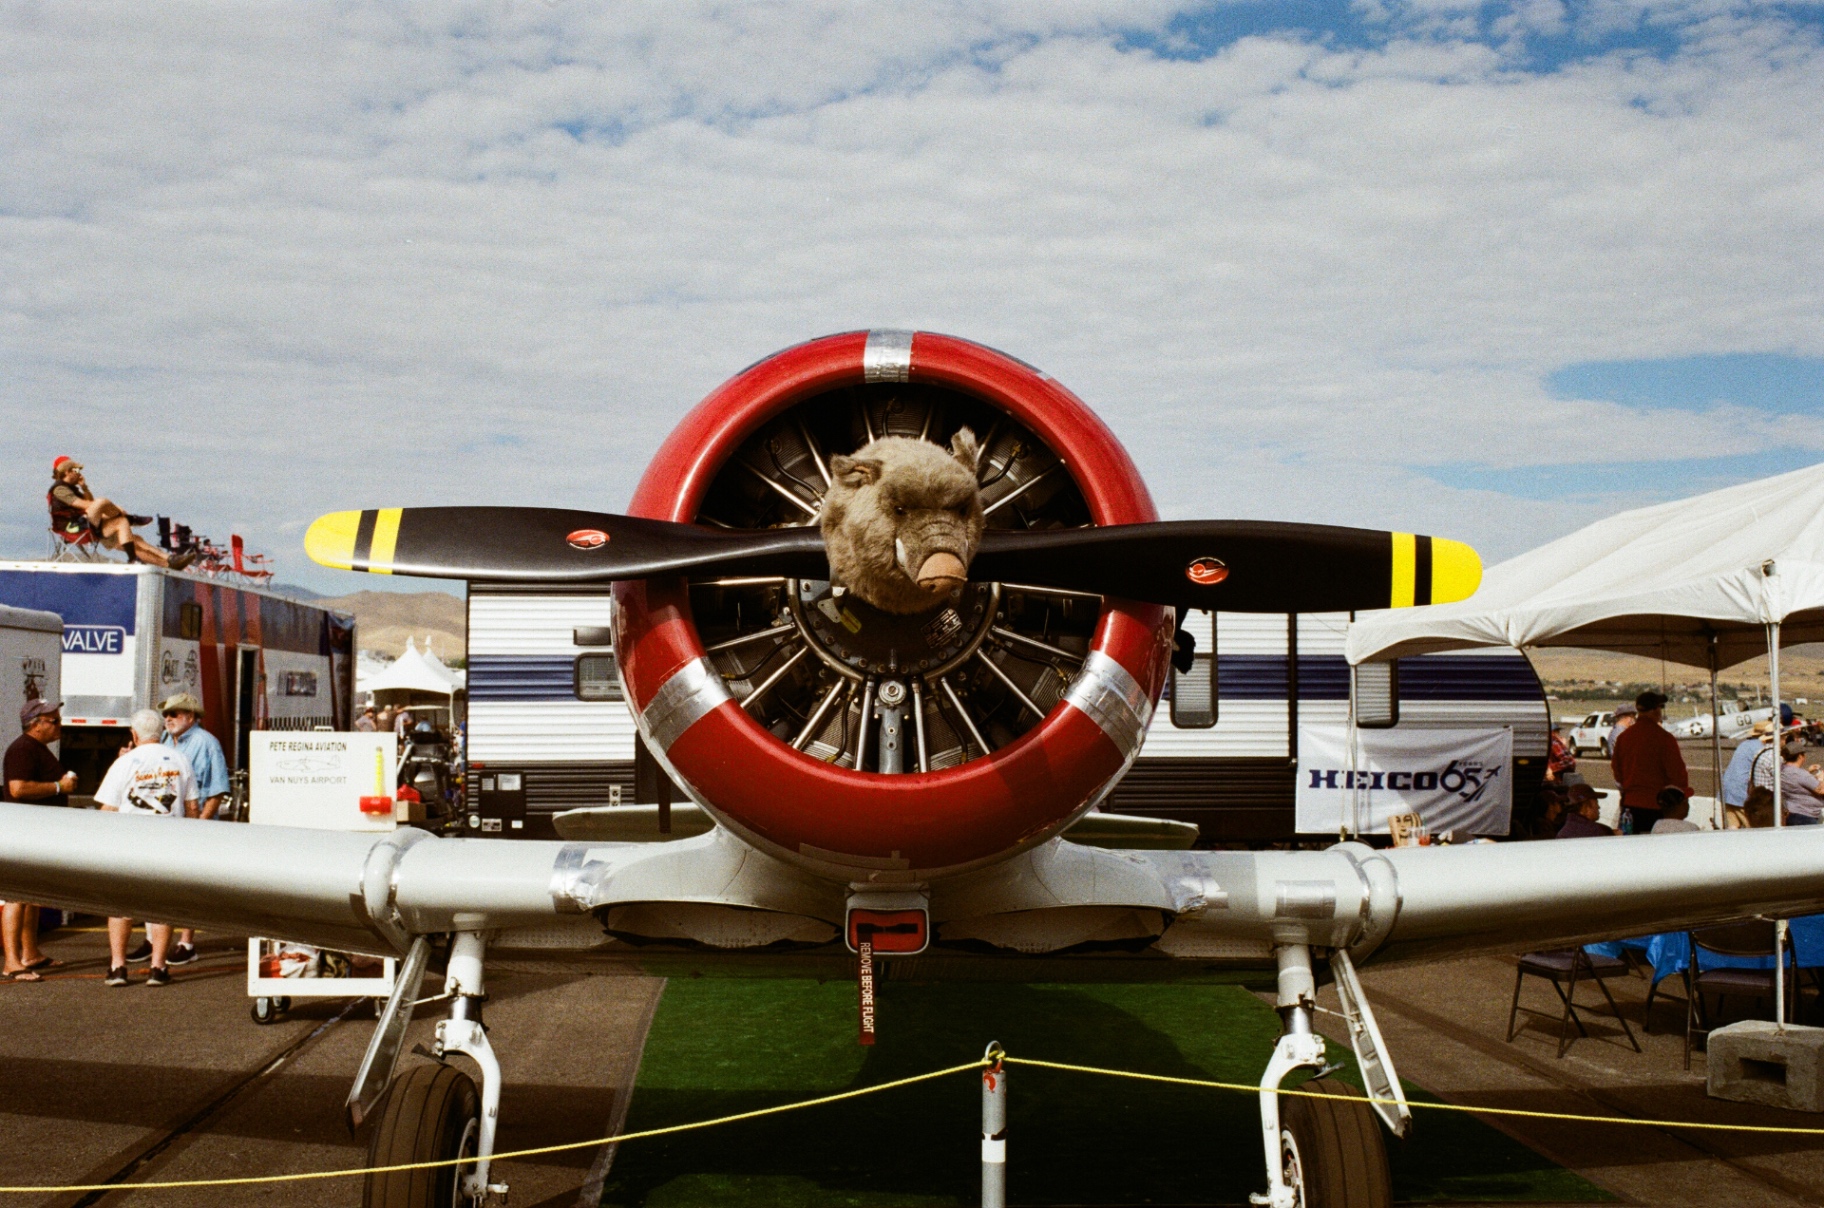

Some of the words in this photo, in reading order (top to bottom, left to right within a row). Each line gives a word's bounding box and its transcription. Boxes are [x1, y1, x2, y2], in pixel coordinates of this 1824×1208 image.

[62, 630, 118, 651] VALVE
[1736, 714, 1752, 727] GQ
[269, 741, 287, 751] PETE
[288, 741, 313, 751] REGINA
[315, 741, 347, 751] AVIATION
[270, 776, 285, 784] VAN
[288, 776, 309, 784] NUYS
[311, 776, 347, 784] AIRPORT
[1309, 769, 1438, 790] HEICO
[860, 942, 872, 974] REMOVE
[861, 975, 873, 1005] BEFORE
[862, 1006, 874, 1033] FLIGHT
